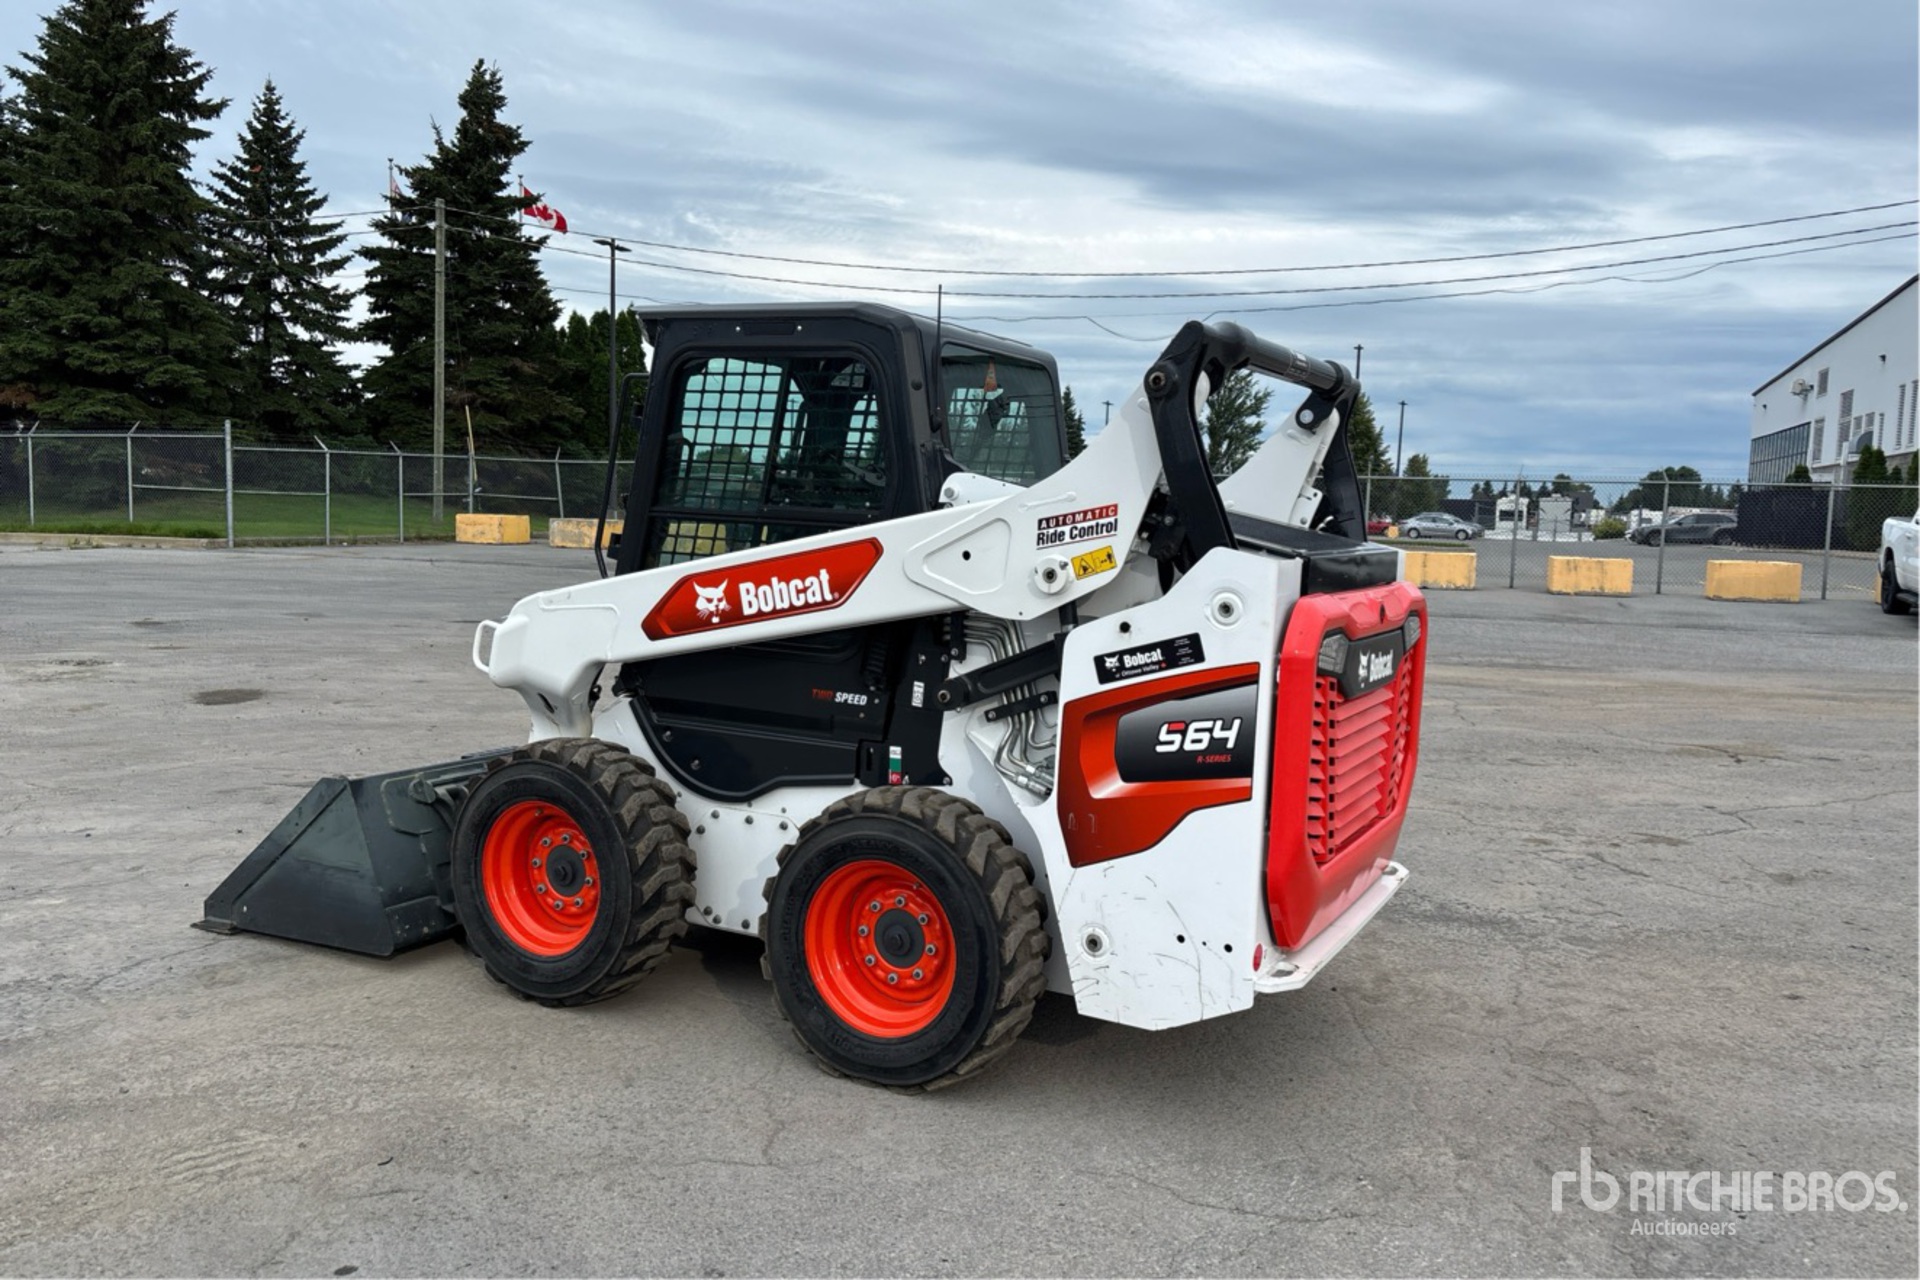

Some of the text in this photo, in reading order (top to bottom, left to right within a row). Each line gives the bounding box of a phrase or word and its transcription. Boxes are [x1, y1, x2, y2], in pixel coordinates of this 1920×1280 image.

[1040, 506, 1116, 529] AUTOMATIC
[1036, 518, 1118, 546] Ride Control
[739, 568, 833, 615] Bobcat
[1123, 648, 1163, 668] Bobcat
[811, 688, 868, 706] TWO SPEED
[1155, 718, 1242, 753] S64
[1196, 754, 1232, 764] R-SERIES
